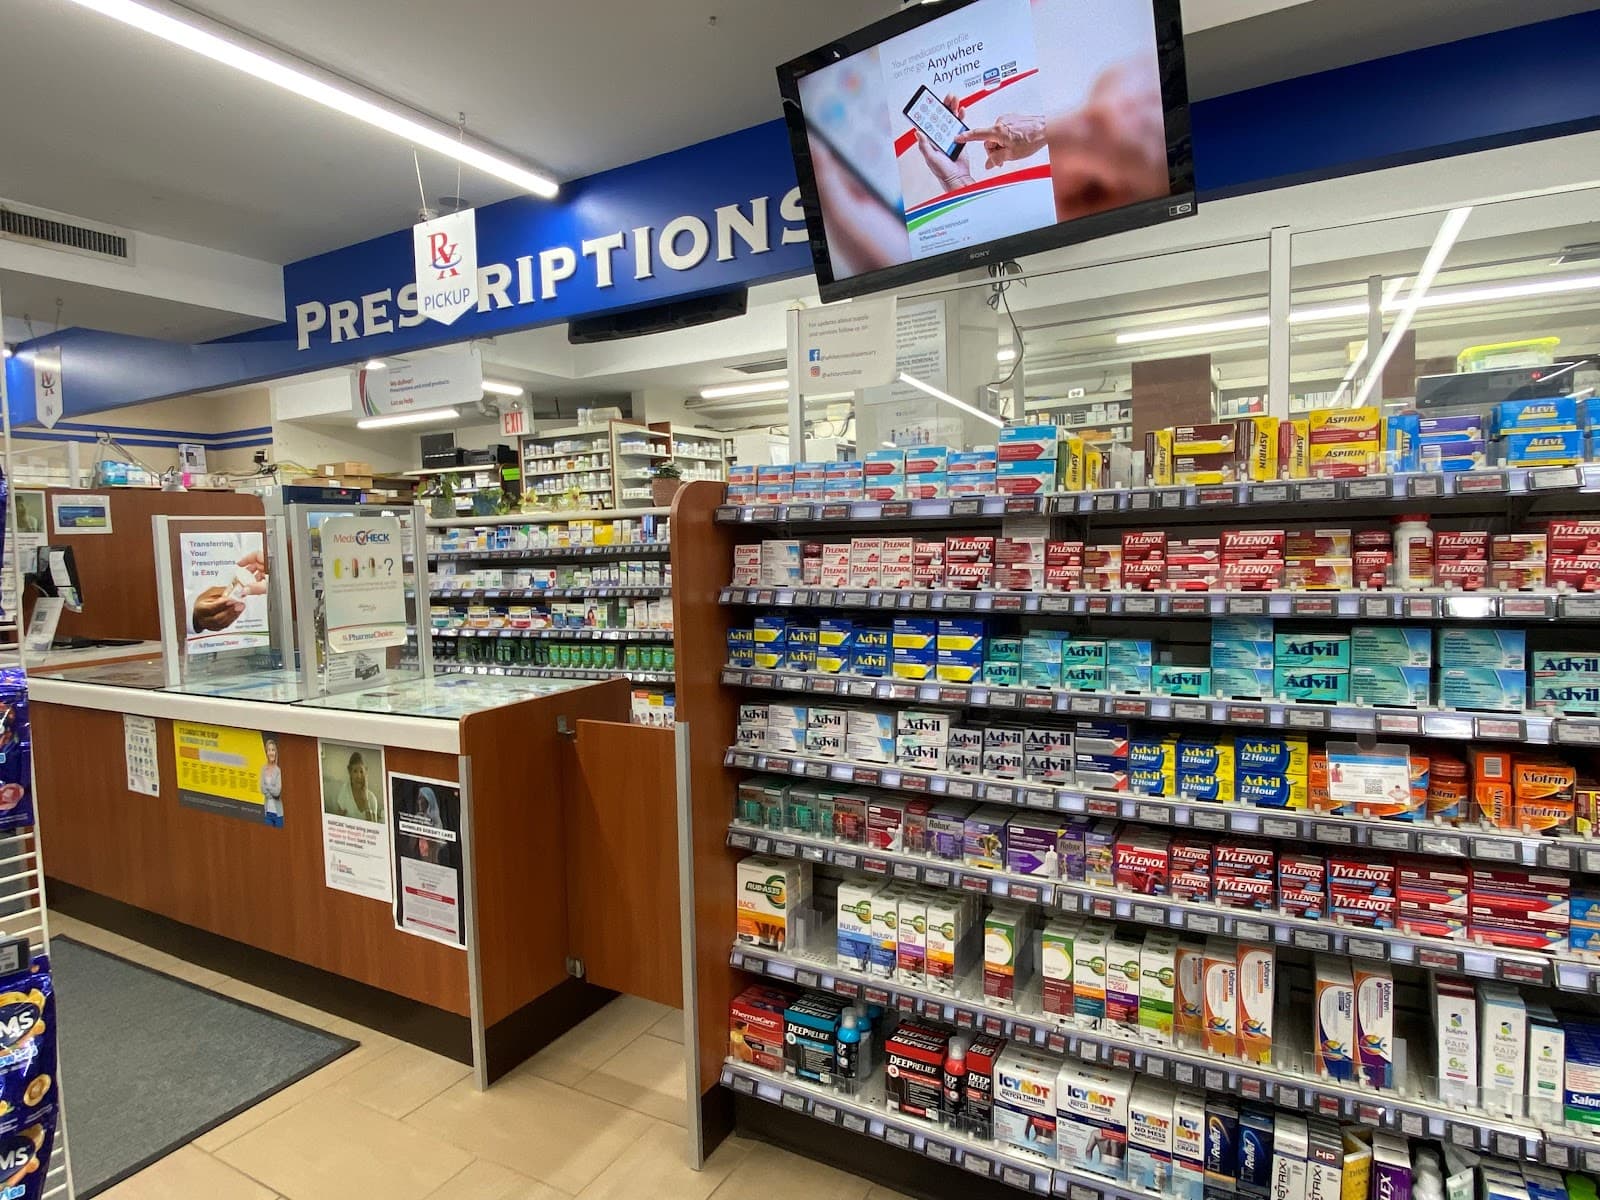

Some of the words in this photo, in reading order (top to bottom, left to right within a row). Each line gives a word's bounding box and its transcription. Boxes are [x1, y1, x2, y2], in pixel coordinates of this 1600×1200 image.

[909, 43, 945, 64] medication
[946, 32, 969, 51] profile
[927, 41, 984, 71] Anywhere
[933, 59, 981, 84] Anytime
[964, 79, 981, 87] TODAY
[970, 250, 991, 259] SONY
[296, 186, 809, 351] PRESRIPTIONS
[424, 287, 471, 312] PICKUP
[1522, 404, 1556, 415] ALEVE
[504, 410, 524, 434] EXIT
[1324, 415, 1365, 425] ASPIRIN
[1529, 437, 1563, 447] ALEVE
[1260, 431, 1269, 470] ASPIRIN
[1296, 434, 1304, 463] ASPIRIN
[1325, 449, 1366, 458] ASPIRIN
[1159, 445, 1167, 478] ASPIRIN
[1071, 453, 1081, 485] ASPIRIN
[1552, 524, 1600, 535] TYLENO
[189, 541, 234, 549] Transferring
[949, 540, 990, 553] TYLENOL
[1125, 535, 1162, 547] TYLENOL
[1225, 535, 1276, 547] TYLENOL
[1440, 536, 1485, 546] TYLENOL
[1048, 544, 1081, 554] TYLENOL
[1125, 560, 1161, 572] TYLENOL
[1224, 564, 1275, 577] TYLENOL
[1439, 565, 1485, 574] TYLENOL
[1552, 559, 1600, 570] TYLENO
[200, 569, 219, 578] Easy
[948, 565, 990, 577] TYLENOL
[1047, 569, 1080, 578] TYLENOL
[349, 631, 394, 641] PharmaChoice
[730, 631, 752, 641] Advil
[789, 631, 817, 641] Advil
[856, 633, 887, 645] Advil
[1066, 646, 1102, 657] Advil
[1285, 640, 1339, 656] Advil
[789, 651, 816, 661] Advil
[855, 655, 885, 667] Advil
[1542, 658, 1598, 672] Advil
[1065, 669, 1102, 680] Advil
[1160, 673, 1202, 685] Advil
[1284, 674, 1338, 689] Advil
[1541, 687, 1599, 701] Advil
[742, 709, 767, 719] Advil
[813, 714, 841, 726] Advil
[904, 718, 940, 731] Advil
[811, 736, 839, 748] Advil
[950, 731, 980, 744] Advil
[987, 731, 1020, 743] Advil
[1027, 731, 1071, 746] Advil
[903, 746, 938, 758] Advil
[1132, 745, 1160, 756] Advil
[1183, 747, 1214, 759] Advil
[1242, 743, 1280, 755] Advil
[948, 755, 978, 766] Advil
[985, 755, 1020, 767] Advil
[1139, 754, 1157, 762] Hour
[1182, 756, 1189, 764] 12
[1190, 757, 1212, 765] Hour
[1241, 752, 1250, 761] 12
[1251, 753, 1276, 763] Hour
[1027, 756, 1071, 772] Advil
[1131, 771, 1160, 781] Advil
[1182, 773, 1214, 785] Advil
[1242, 774, 1280, 788] Advil
[1519, 770, 1568, 785] Motrin
[1131, 778, 1138, 786] 12
[1138, 779, 1157, 787] Hour
[1181, 782, 1188, 790] 12
[1189, 783, 1212, 793] Hour
[1241, 786, 1250, 794] 12
[1251, 786, 1277, 797] Hour
[929, 820, 950, 830] Robax
[1119, 853, 1166, 869] TYLENOL
[1173, 849, 1208, 861] TYLENOL
[1217, 849, 1270, 866] TYLENOL
[1119, 863, 1133, 871] BACK
[1134, 865, 1147, 873] PAIN
[1281, 863, 1321, 879] TYLENOL
[1332, 865, 1391, 882] TYLENOL
[1172, 877, 1208, 889] TYLENOL
[1216, 878, 1270, 895] TYLENOL
[1283, 890, 1322, 904] TYLENOL
[1333, 894, 1393, 913] TYLENOL
[1345, 991, 1353, 1022] Voltaren
[732, 1009, 779, 1028] ThermaCare
[1444, 1040, 1470, 1051] PAIN
[1493, 1046, 1520, 1059] PAIN
[969, 1073, 990, 1084] DEEP
[968, 1080, 990, 1091] RELIEF
[1002, 1089, 1022, 1100] PATCH
[1069, 1099, 1089, 1110] PATCH
[1179, 1116, 1199, 1130] ICY
[1134, 1126, 1147, 1134] NO
[1147, 1129, 1167, 1139] MESS
[1177, 1144, 1201, 1154] CREAM
[1315, 1150, 1337, 1162] HP
[1275, 1158, 1289, 1200] STRIX
